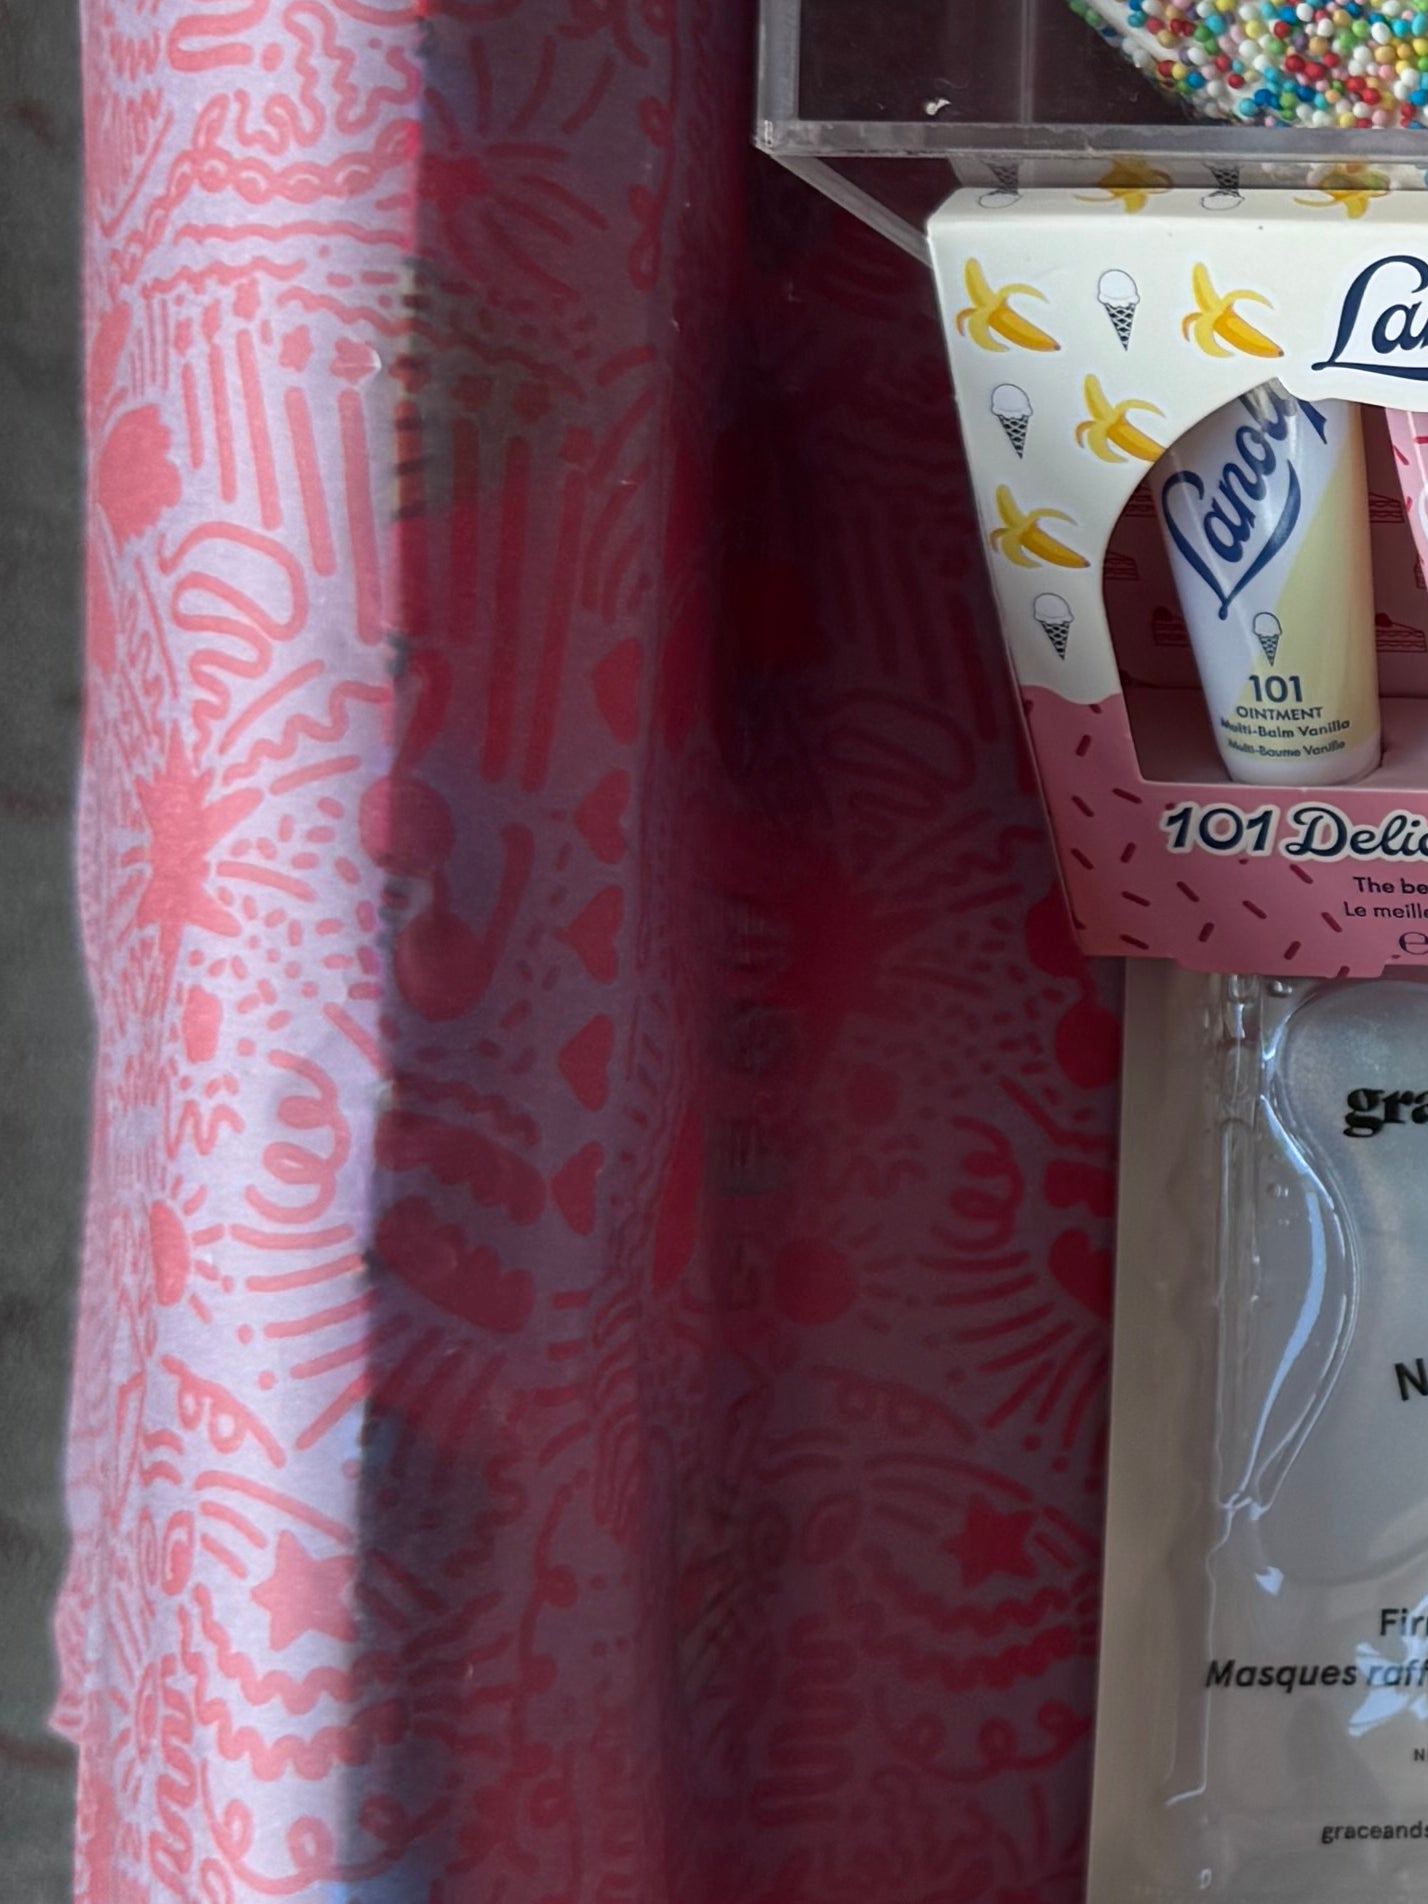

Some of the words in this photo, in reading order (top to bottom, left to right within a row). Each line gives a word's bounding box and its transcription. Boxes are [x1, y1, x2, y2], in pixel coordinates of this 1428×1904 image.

[1248, 674, 1304, 703] 101
[1236, 706, 1324, 721] OINTMENT
[1298, 720, 1350, 737] Vanilla
[1164, 805, 1275, 853] 101
[1353, 876, 1396, 895] The
[1344, 901, 1367, 917] Le
[1204, 1659, 1358, 1695] Masques
